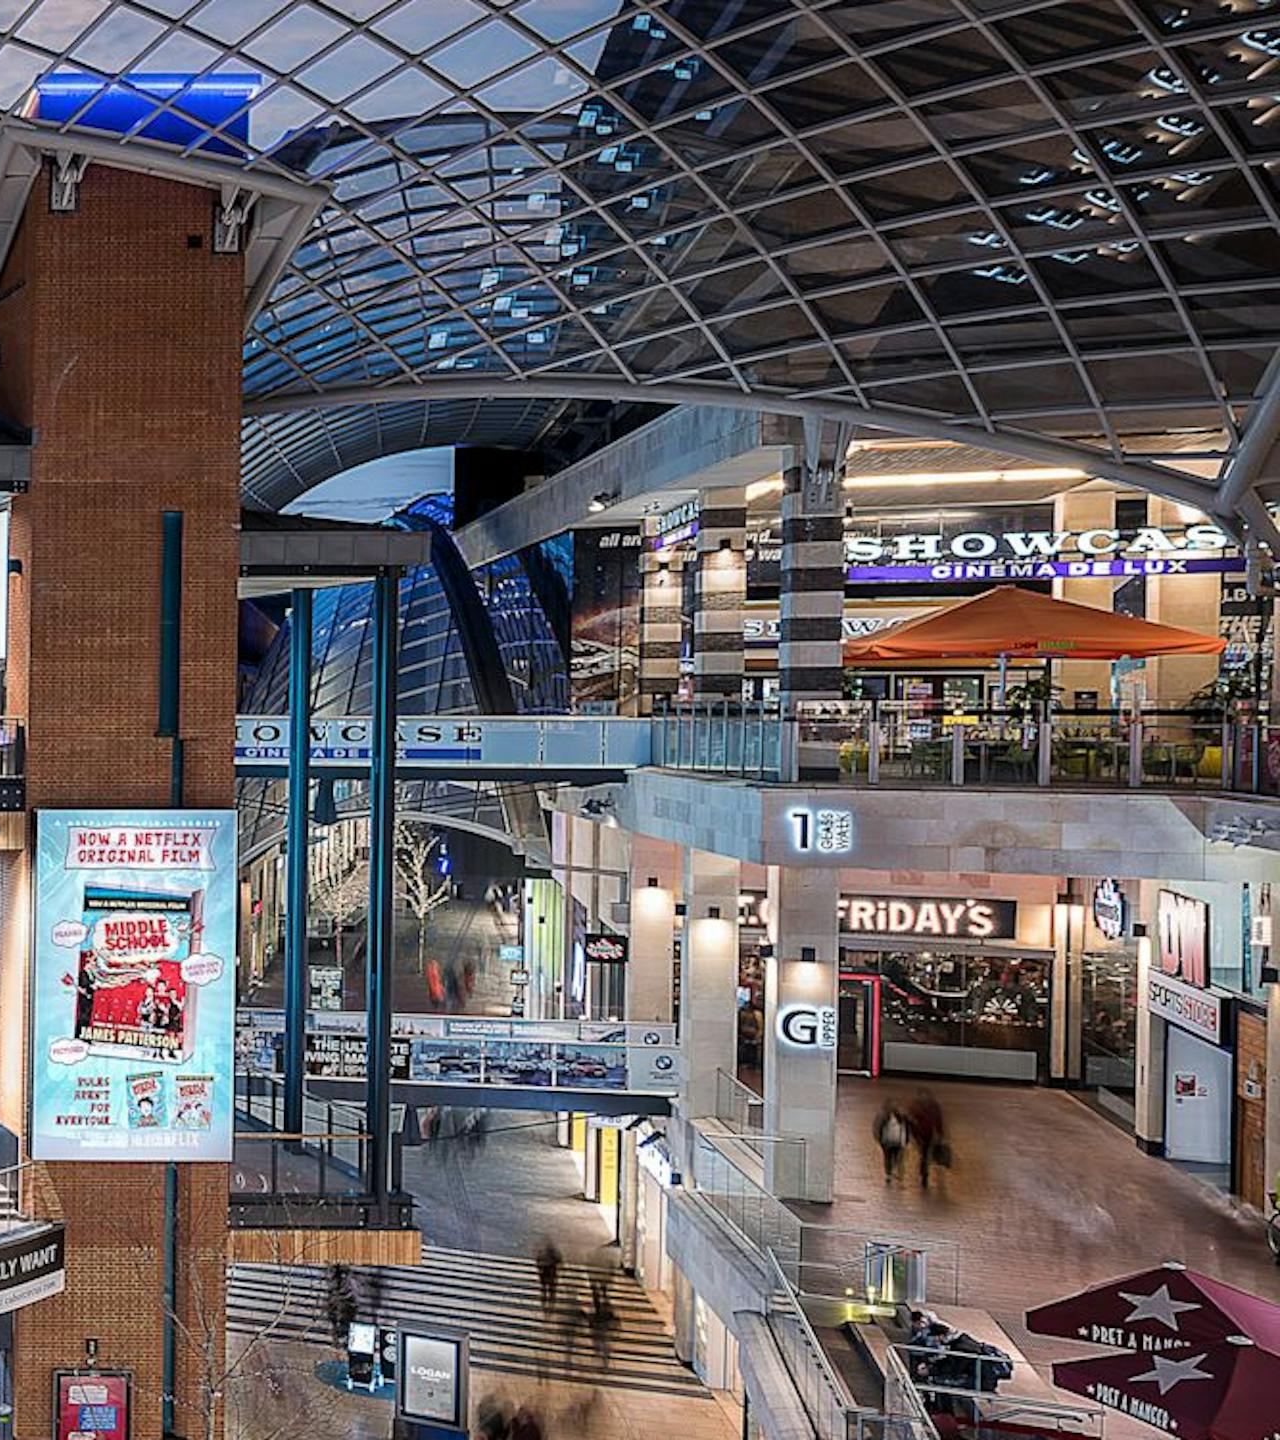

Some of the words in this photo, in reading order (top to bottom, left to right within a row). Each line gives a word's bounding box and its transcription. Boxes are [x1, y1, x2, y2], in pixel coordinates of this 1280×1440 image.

[847, 525, 1227, 561] SHOWCAS
[931, 564, 1056, 579] CINEMA
[1069, 560, 1111, 576] DE
[1123, 558, 1187, 575] LUX
[246, 747, 326, 758] CINEA
[333, 748, 360, 758] DE
[78, 832, 110, 846] NOW
[118, 833, 127, 846] A
[135, 832, 202, 847] NETFLIX
[793, 813, 808, 848] 1
[821, 813, 833, 849] GLASS
[836, 813, 850, 848] WALK
[77, 850, 154, 863] ORIGINAL
[161, 850, 200, 863] FILM
[104, 919, 168, 938] MIDDLE
[1159, 889, 1207, 989] DW
[105, 936, 171, 951] SCHOOL
[80, 1026, 115, 1042] JAMES
[117, 1028, 179, 1048] PATTERSON
[782, 1010, 817, 1044] G
[823, 1011, 835, 1047] UPPER
[313, 1040, 339, 1051] THE
[19, 1243, 58, 1273] WANT
[1092, 1324, 1124, 1345] PRET
[1127, 1332, 1137, 1348] A
[411, 1365, 450, 1380] LOGAN
[1096, 1382, 1120, 1407] PRET
[1121, 1394, 1128, 1412] A
